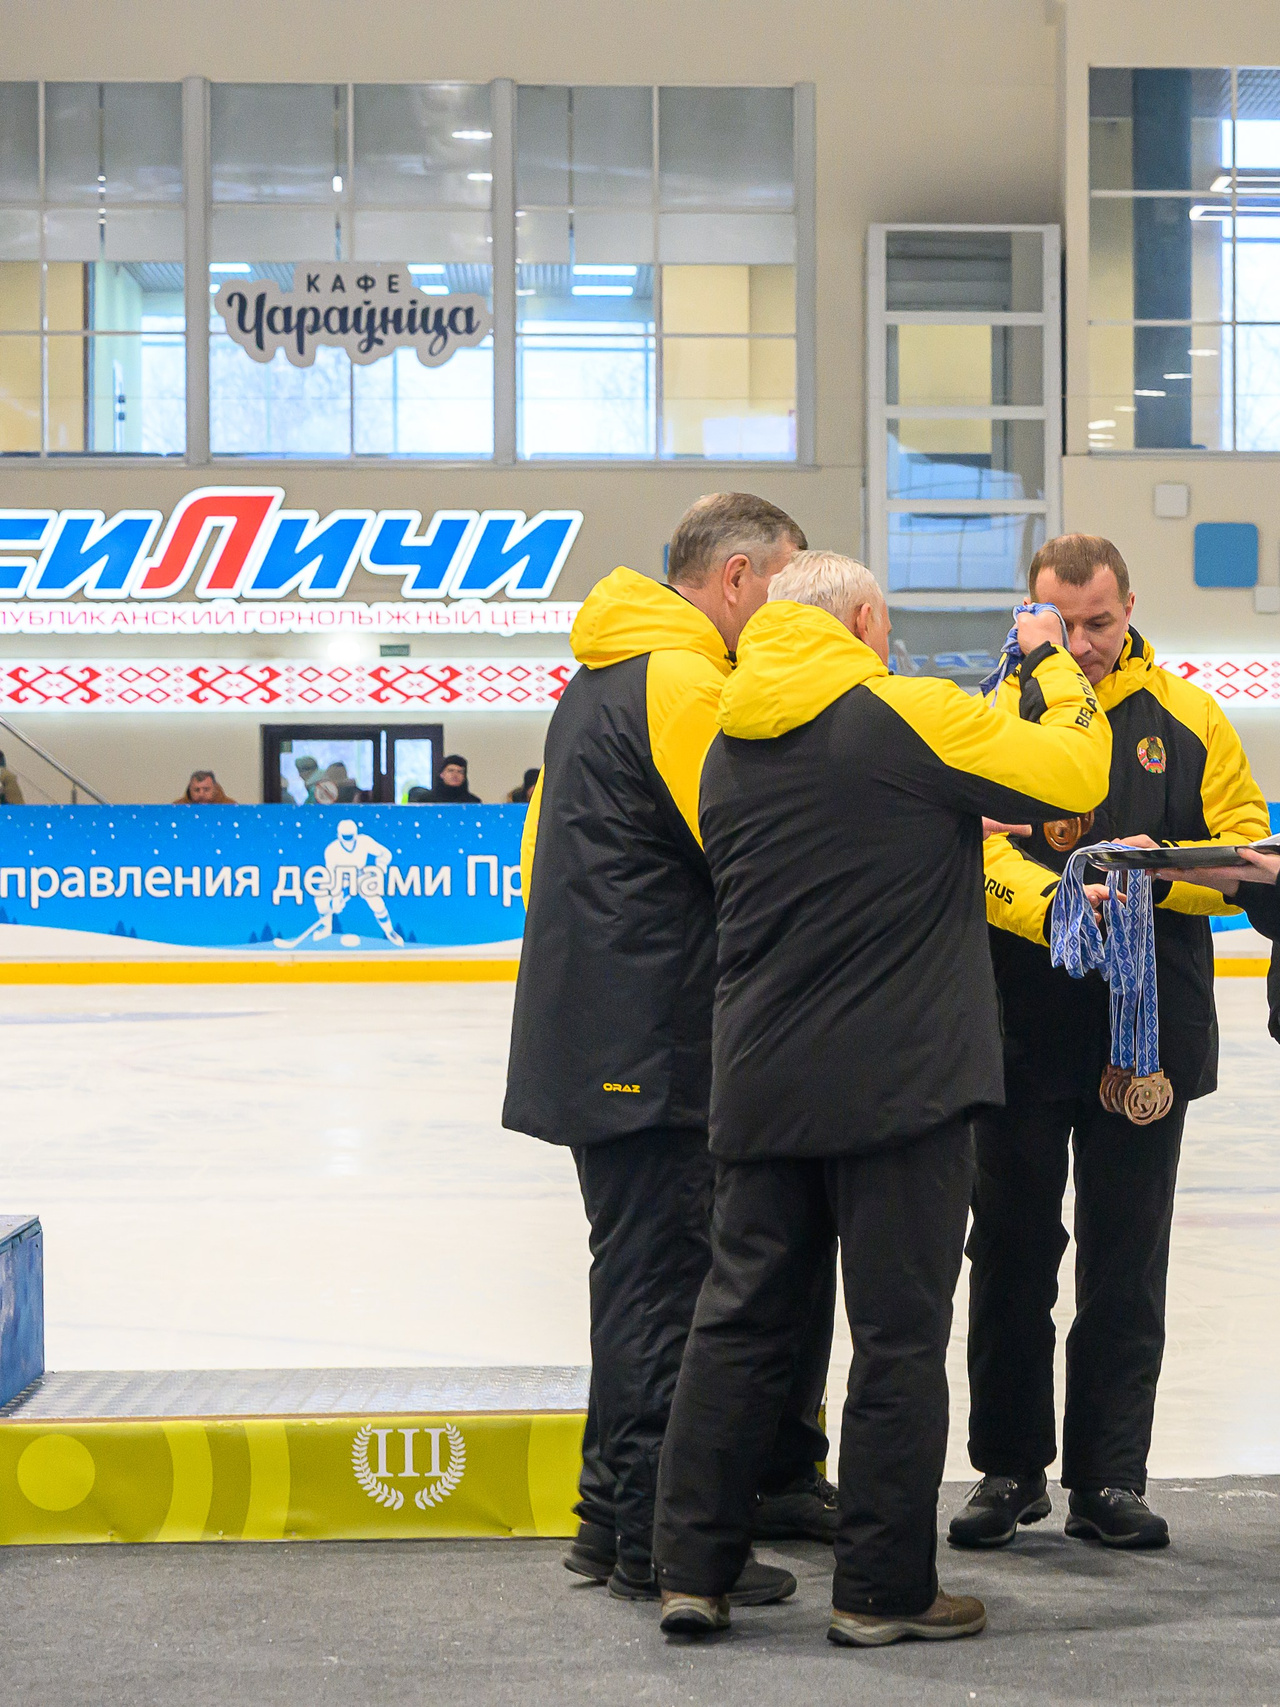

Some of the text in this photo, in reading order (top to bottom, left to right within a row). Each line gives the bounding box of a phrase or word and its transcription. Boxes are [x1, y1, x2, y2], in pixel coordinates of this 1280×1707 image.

[306, 273, 400, 294] КАФЕ
[226, 291, 481, 357] Чараўніца
[243, 607, 481, 625] ГОРНОЛЫЖНЫЙ
[272, 864, 452, 906] делами
[602, 1082, 641, 1094] ORAZ
